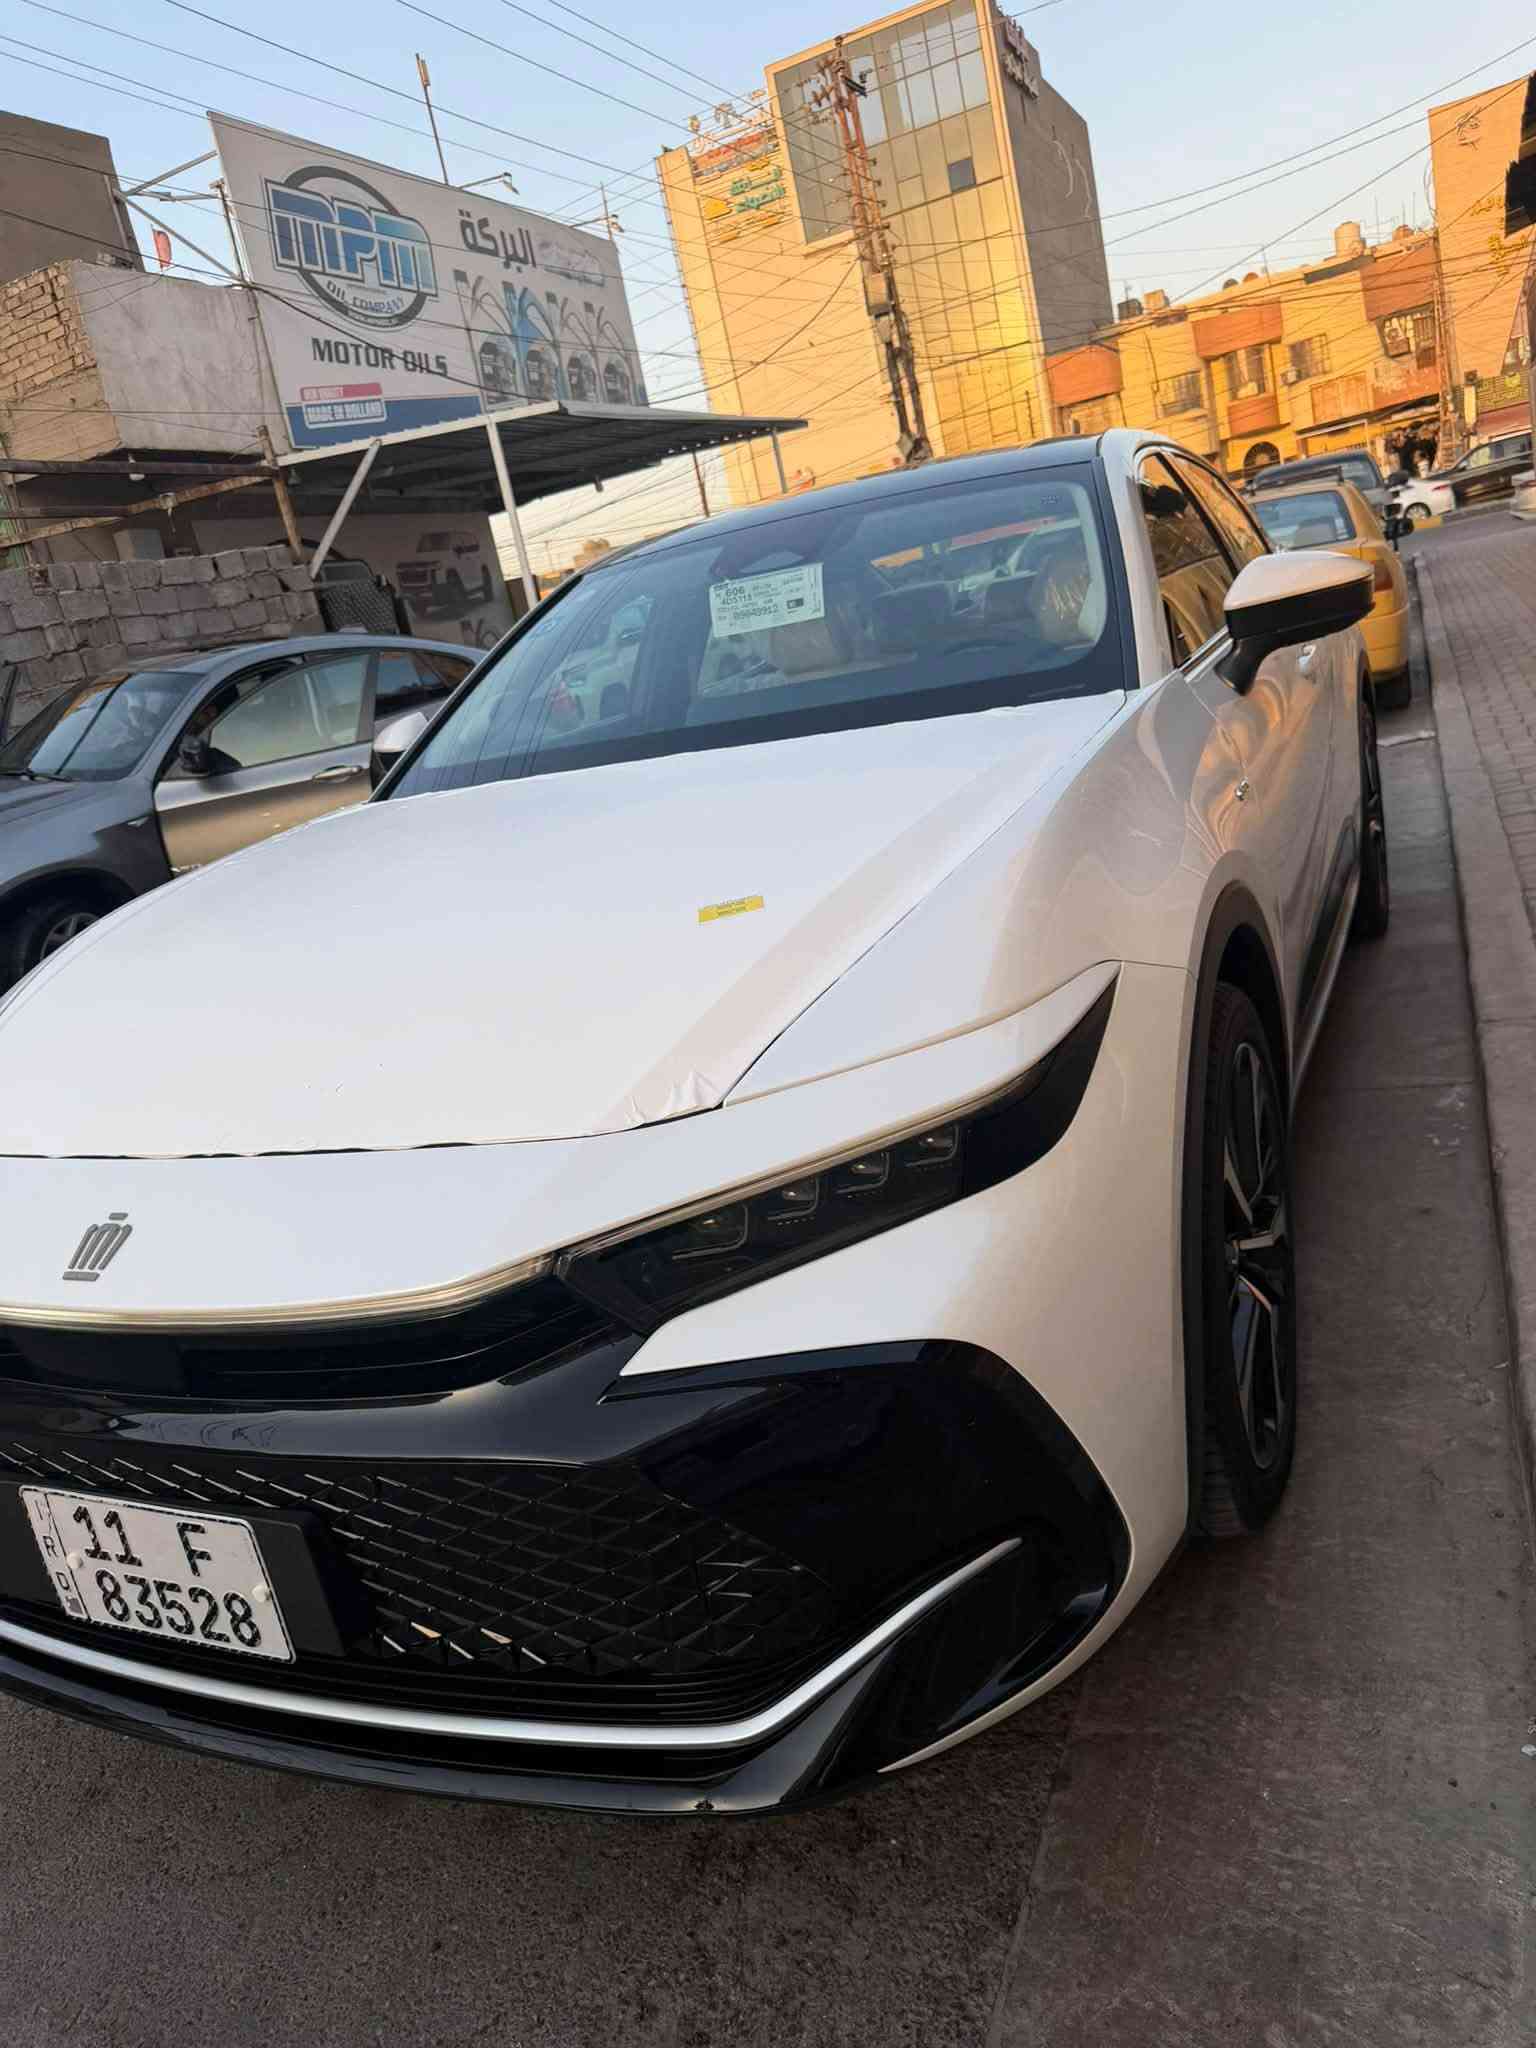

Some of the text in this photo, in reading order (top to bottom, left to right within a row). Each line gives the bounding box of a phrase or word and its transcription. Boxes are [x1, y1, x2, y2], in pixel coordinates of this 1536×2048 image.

[458, 208, 537, 273] البركة
[327, 280, 405, 314] OIL COMPANY
[311, 337, 449, 377] MOTOR OILS
[73, 1506, 212, 1577] 11 F
[95, 1568, 262, 1648] 83528
